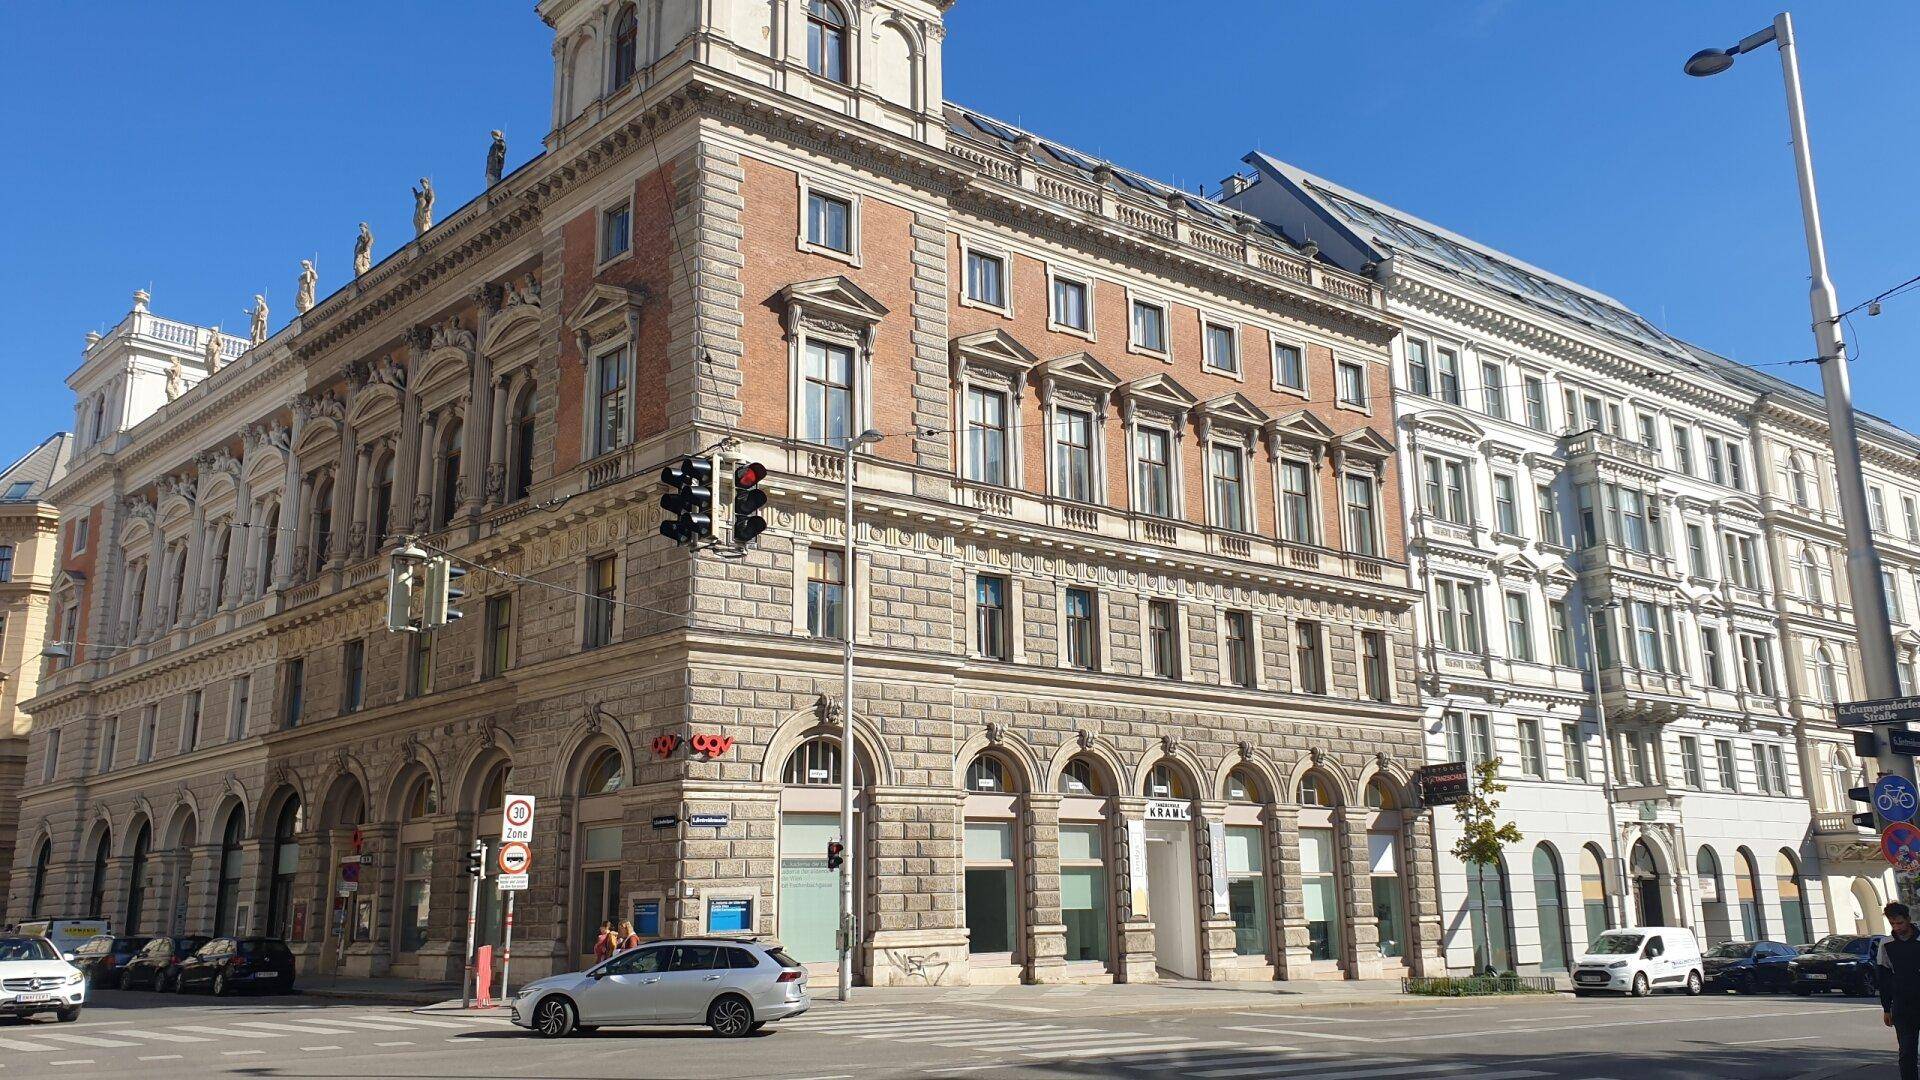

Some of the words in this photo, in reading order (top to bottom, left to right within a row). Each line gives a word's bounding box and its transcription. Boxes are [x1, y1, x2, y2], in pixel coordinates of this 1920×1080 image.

[1863, 711, 1898, 722] Straße
[514, 806, 525, 819] 30
[1150, 807, 1186, 819] KRAML
[507, 828, 528, 838] Zone
